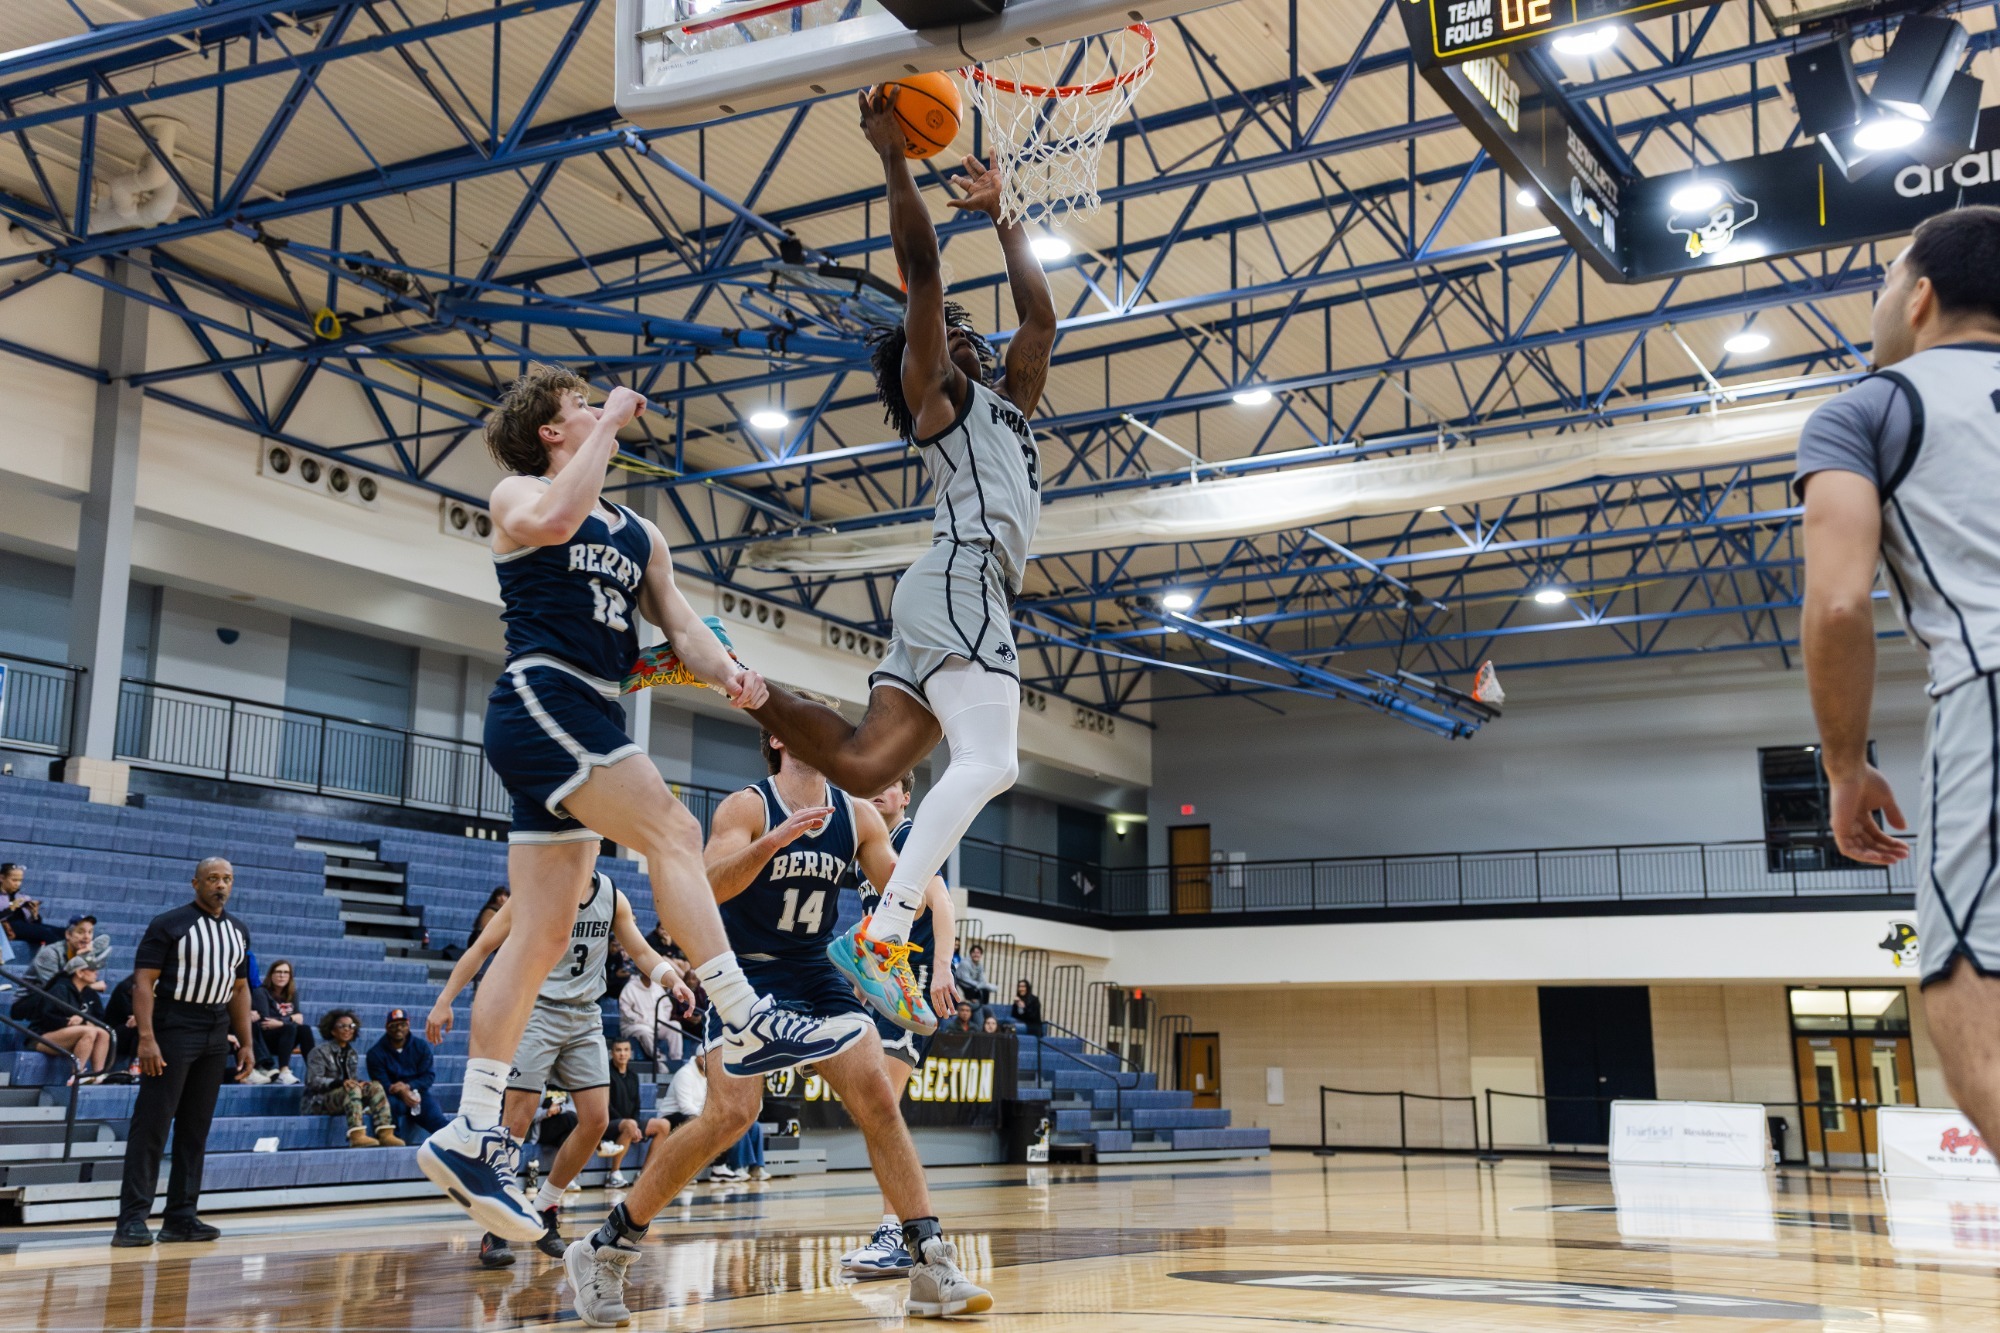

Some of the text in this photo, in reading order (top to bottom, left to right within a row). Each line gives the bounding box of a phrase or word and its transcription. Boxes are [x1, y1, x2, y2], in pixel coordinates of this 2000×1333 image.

[1448, 0, 1491, 24] TEAM
[1445, 19, 1493, 47] FOULS
[568, 543, 642, 592] BERRY
[588, 577, 629, 633] 12
[769, 851, 847, 885] BERRY
[777, 887, 827, 934] 14
[570, 943, 589, 977] 3
[908, 1056, 995, 1103] SECTION
